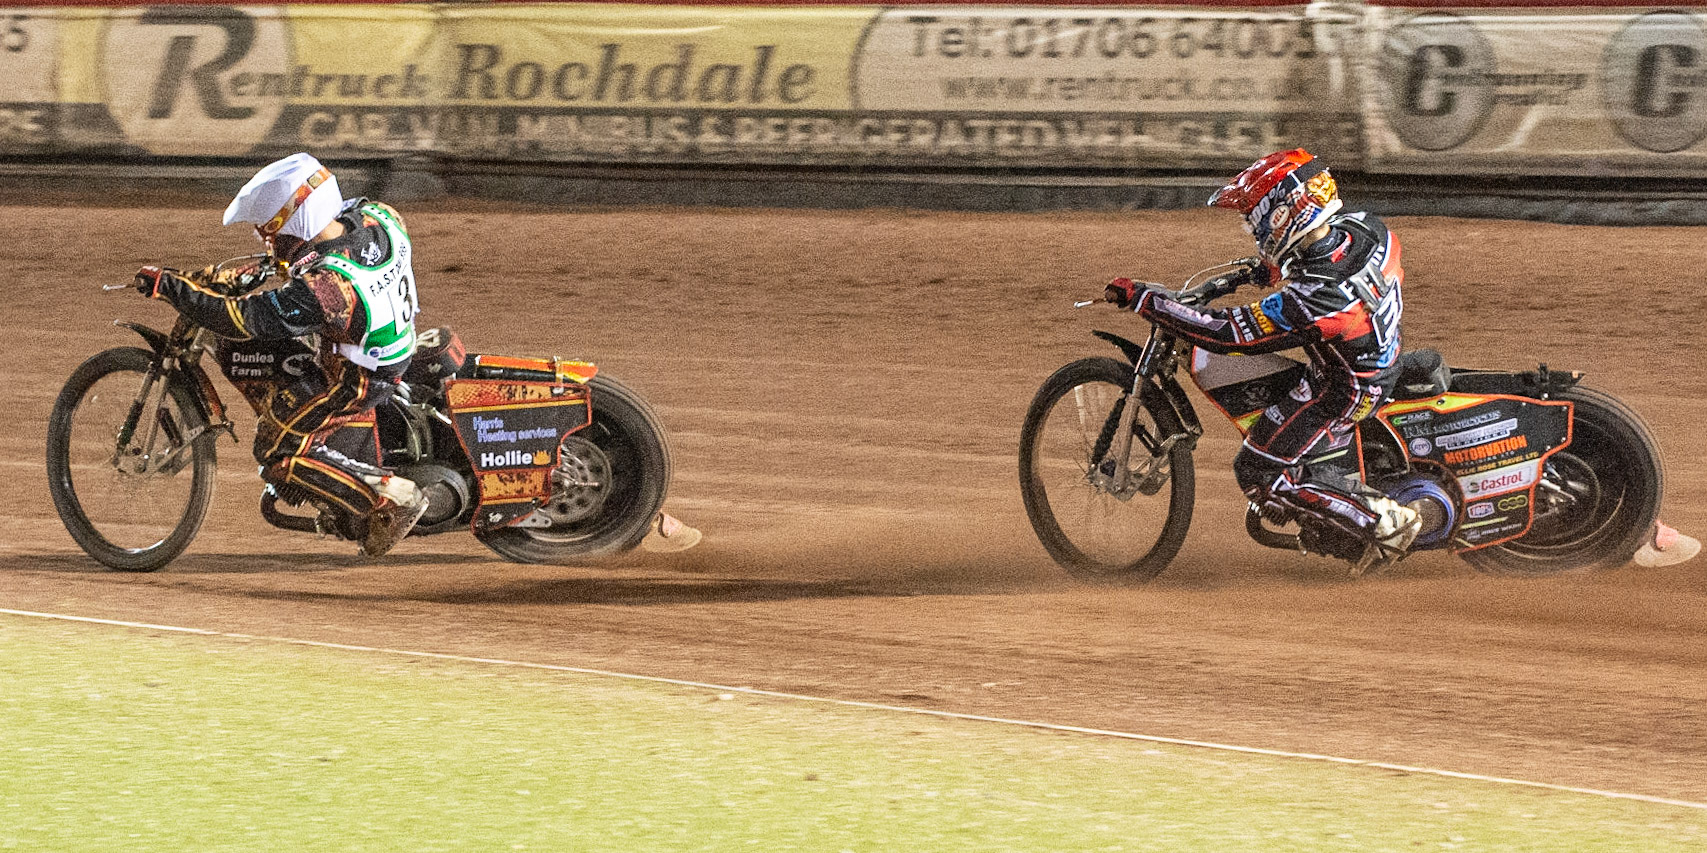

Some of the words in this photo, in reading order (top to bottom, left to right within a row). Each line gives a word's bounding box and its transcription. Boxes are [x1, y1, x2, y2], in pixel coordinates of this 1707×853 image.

[905, 14, 995, 58] Tel:
[1007, 16, 1159, 59] 01706
[140, 6, 430, 119] Rentruck
[445, 43, 816, 104] Rochdale
[398, 275, 413, 323] 3
[232, 351, 275, 364] Dunlea
[477, 428, 517, 443] Heating
[518, 427, 557, 440] services
[481, 450, 533, 468] Hollie
[1444, 435, 1528, 464] MOTORVATION
[1480, 471, 1523, 491] Castrol
